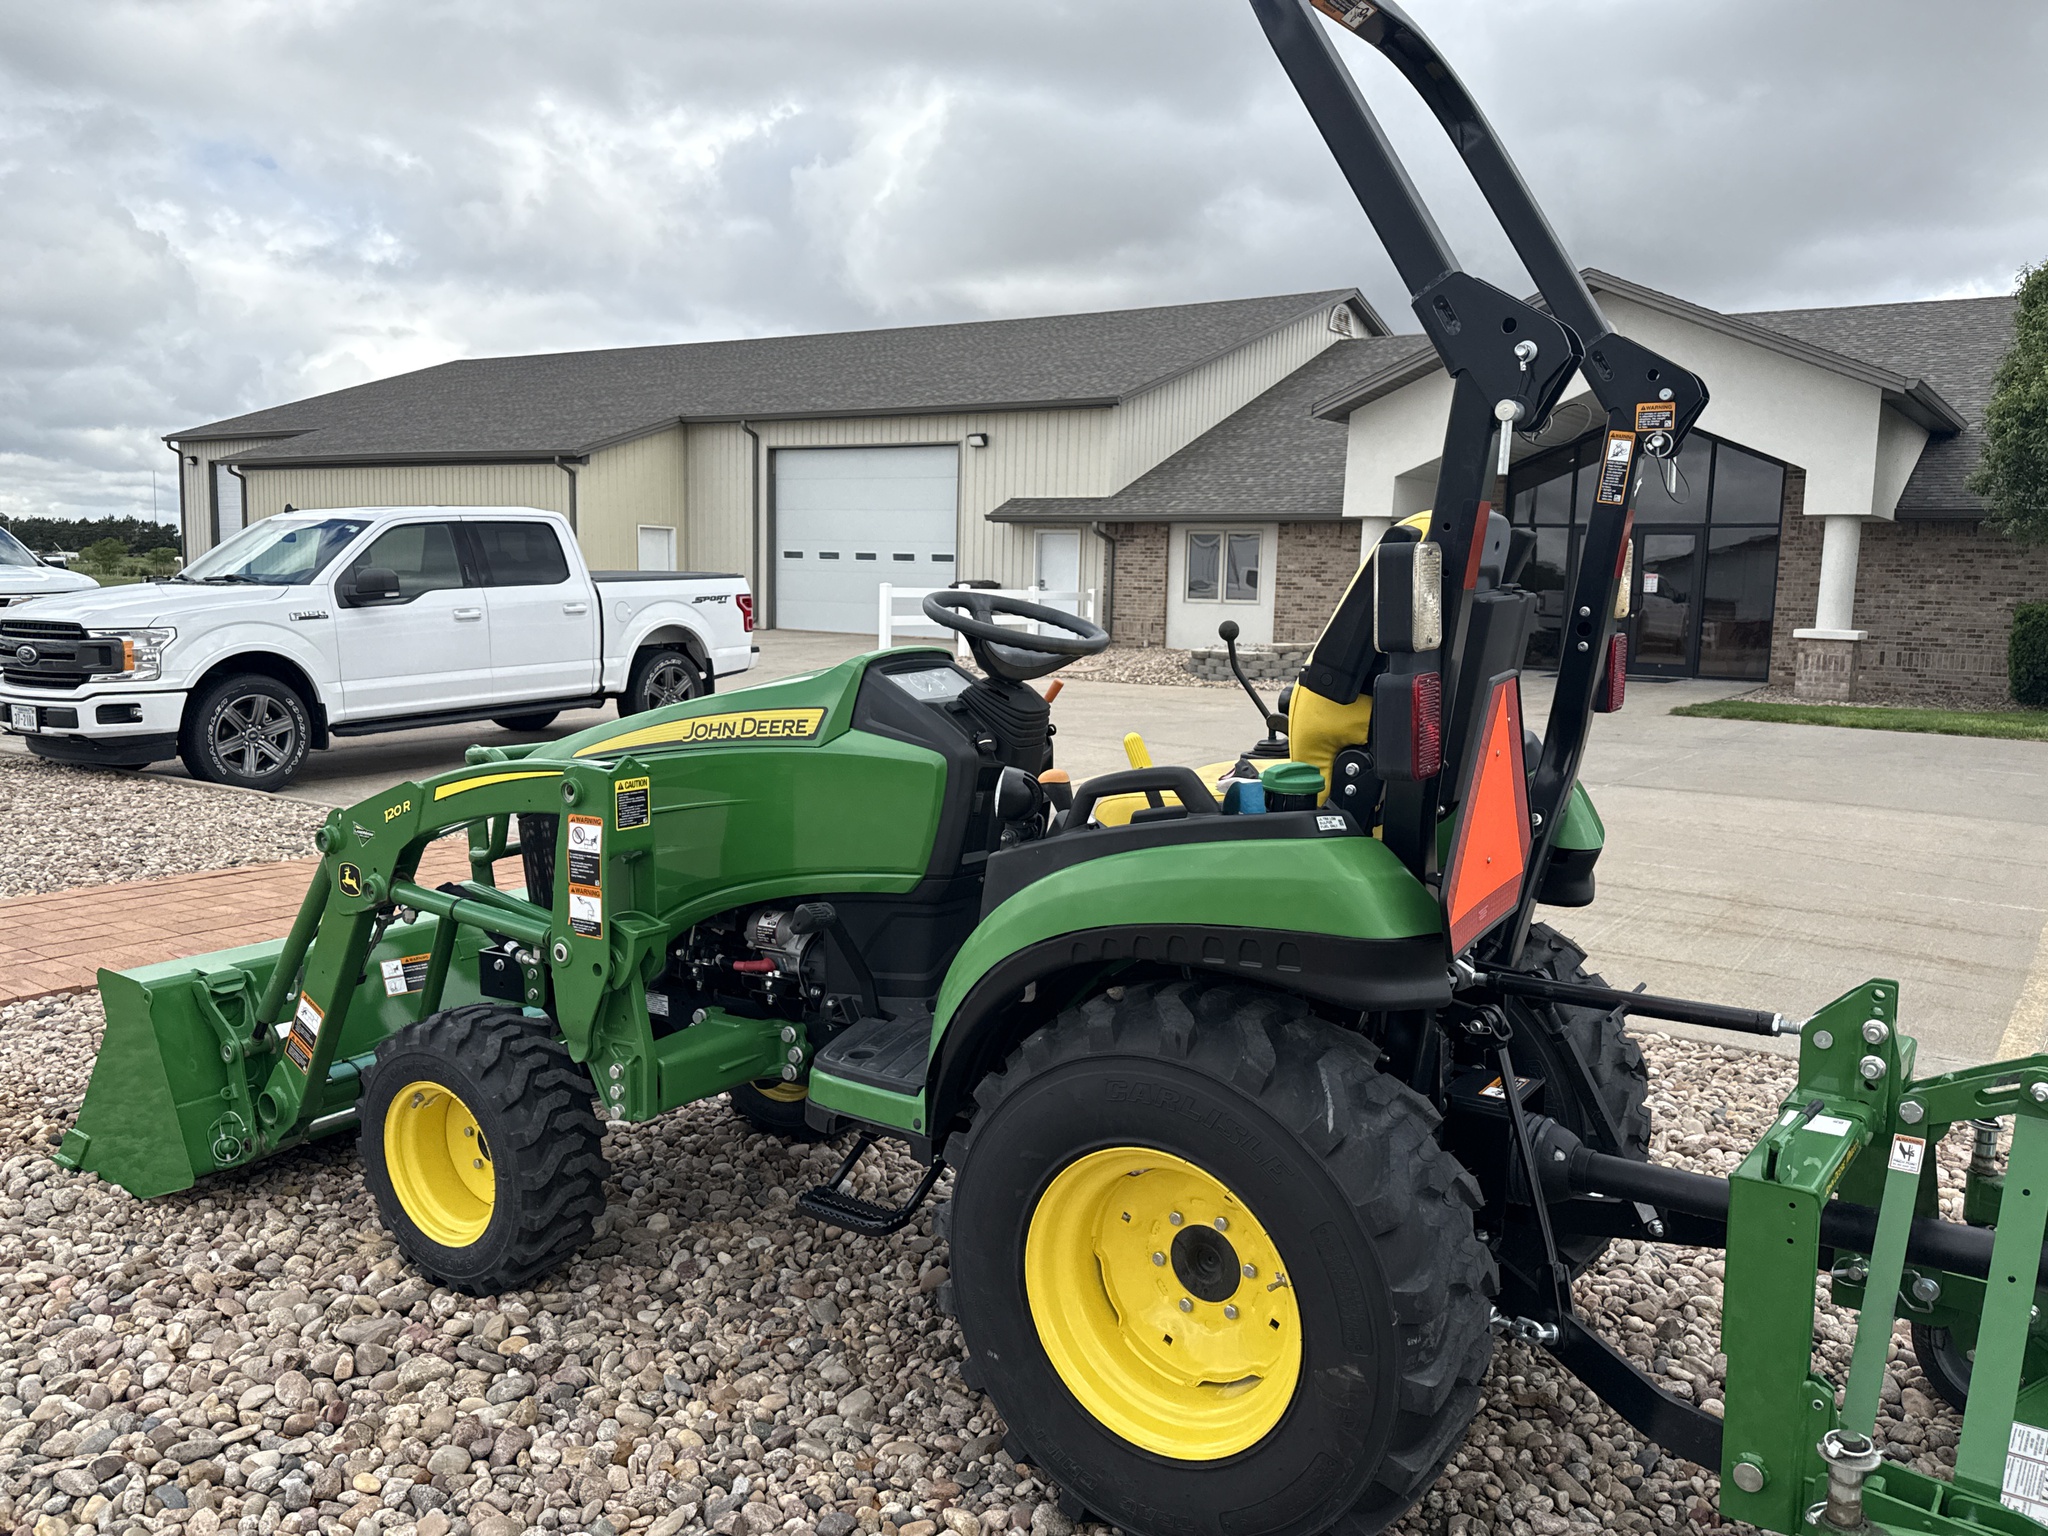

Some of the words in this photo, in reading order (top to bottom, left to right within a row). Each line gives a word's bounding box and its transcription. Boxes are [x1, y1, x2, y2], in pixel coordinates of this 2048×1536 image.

[691, 594, 731, 604] SPORT
[207, 698, 228, 776] WRANGLER
[285, 697, 307, 775] GOODYEAR
[682, 721, 736, 741] JOHN
[740, 717, 809, 736] DEERE
[624, 779, 648, 790] CAUTION
[575, 815, 602, 826] WARNING
[575, 888, 601, 898] WARNING
[1104, 1078, 1295, 1185] CARLISLE
